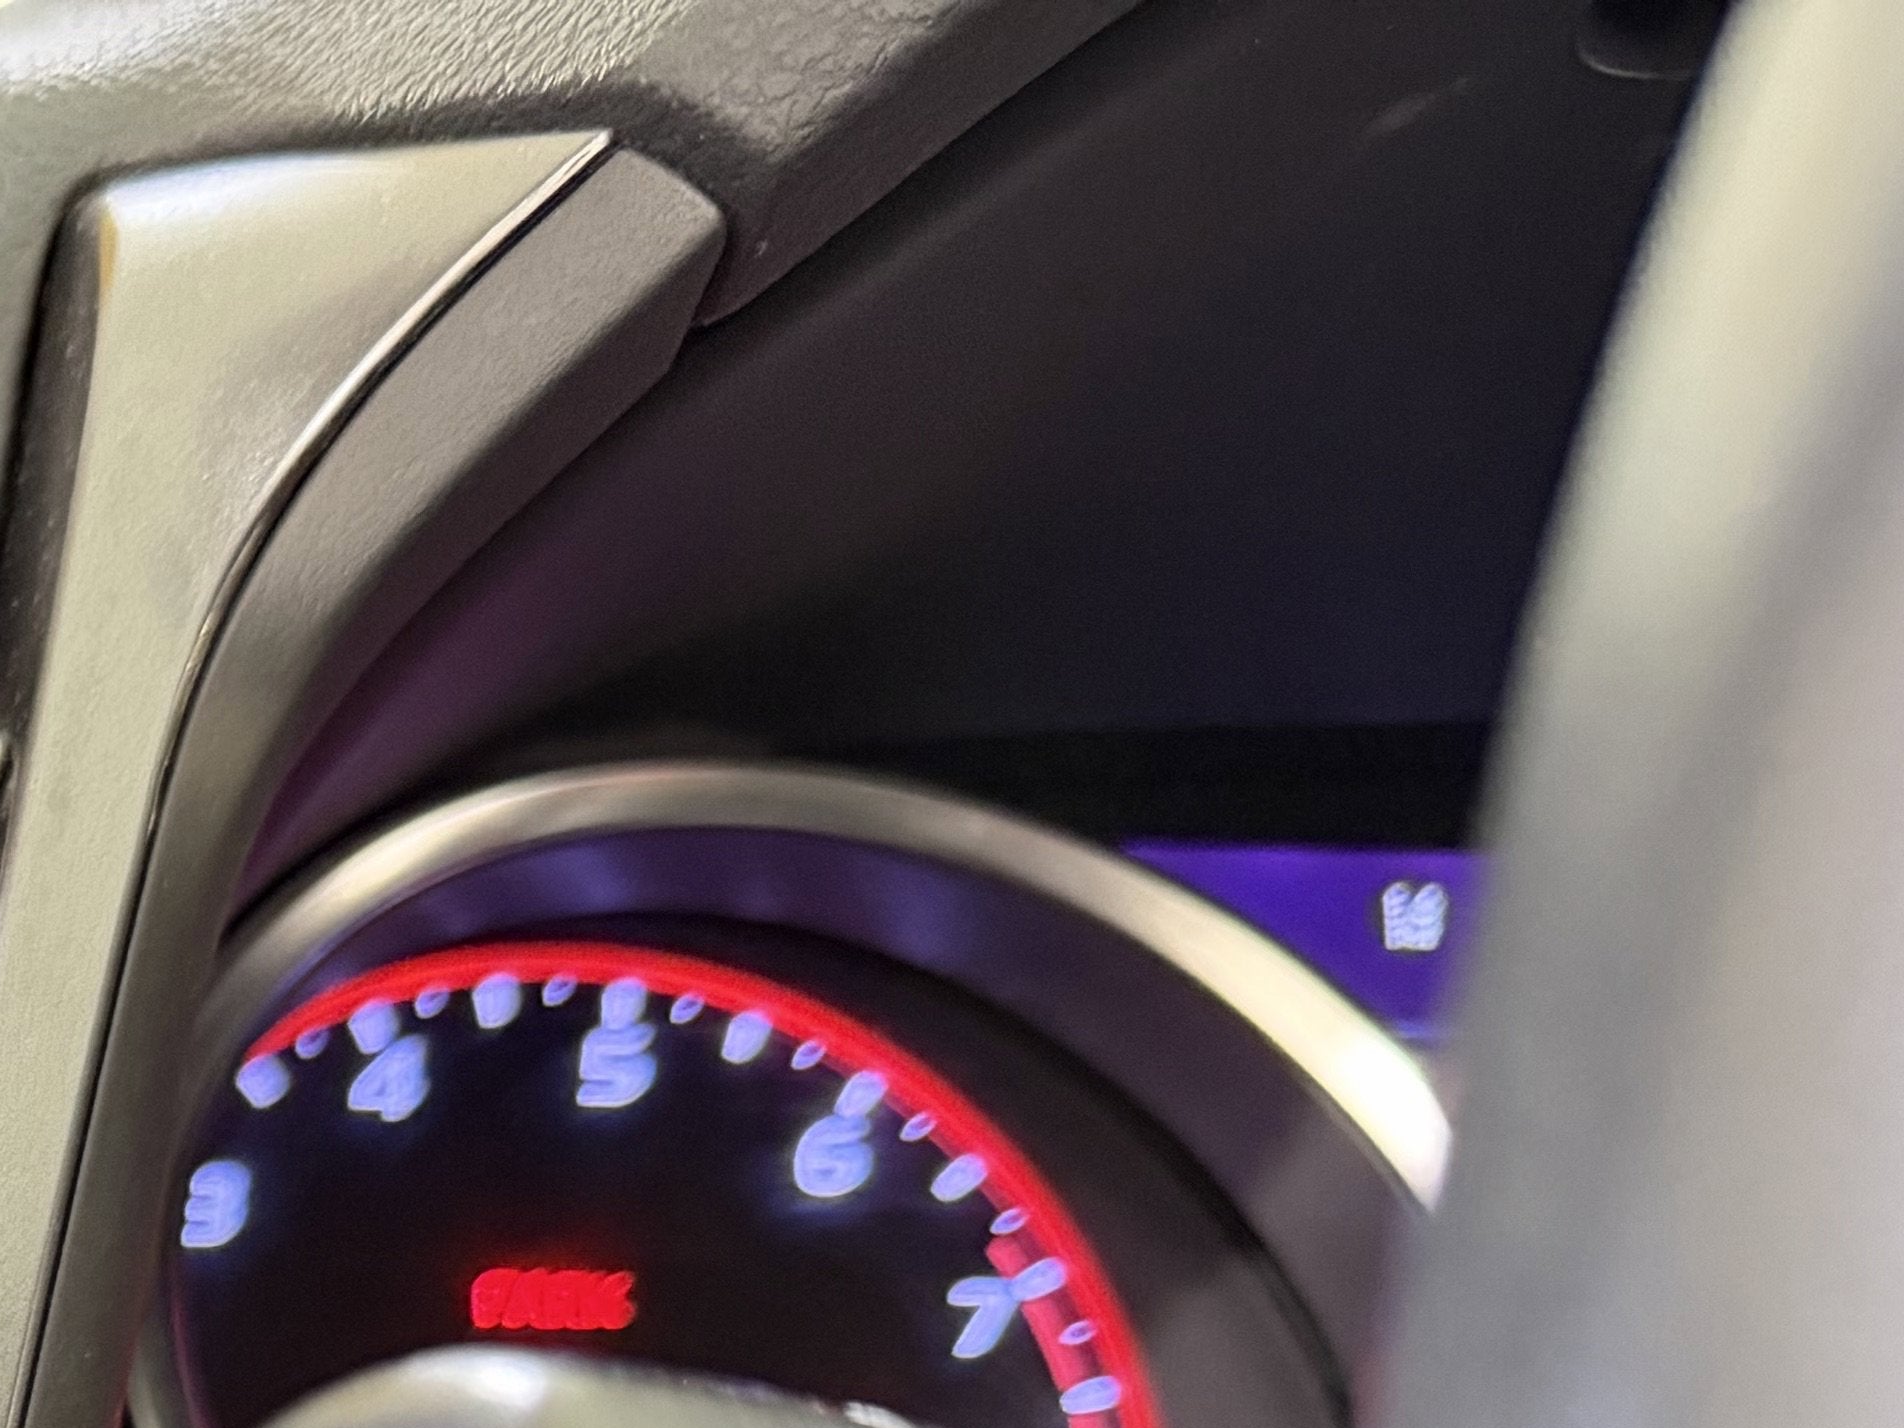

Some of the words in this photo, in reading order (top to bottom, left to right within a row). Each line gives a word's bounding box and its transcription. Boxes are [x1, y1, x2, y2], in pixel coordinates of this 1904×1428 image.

[180, 1160, 252, 1248] 3
[347, 1033, 430, 1122] 4
[575, 1022, 658, 1107] 5
[793, 1112, 875, 1197] 6
[946, 1275, 1020, 1359] 7
